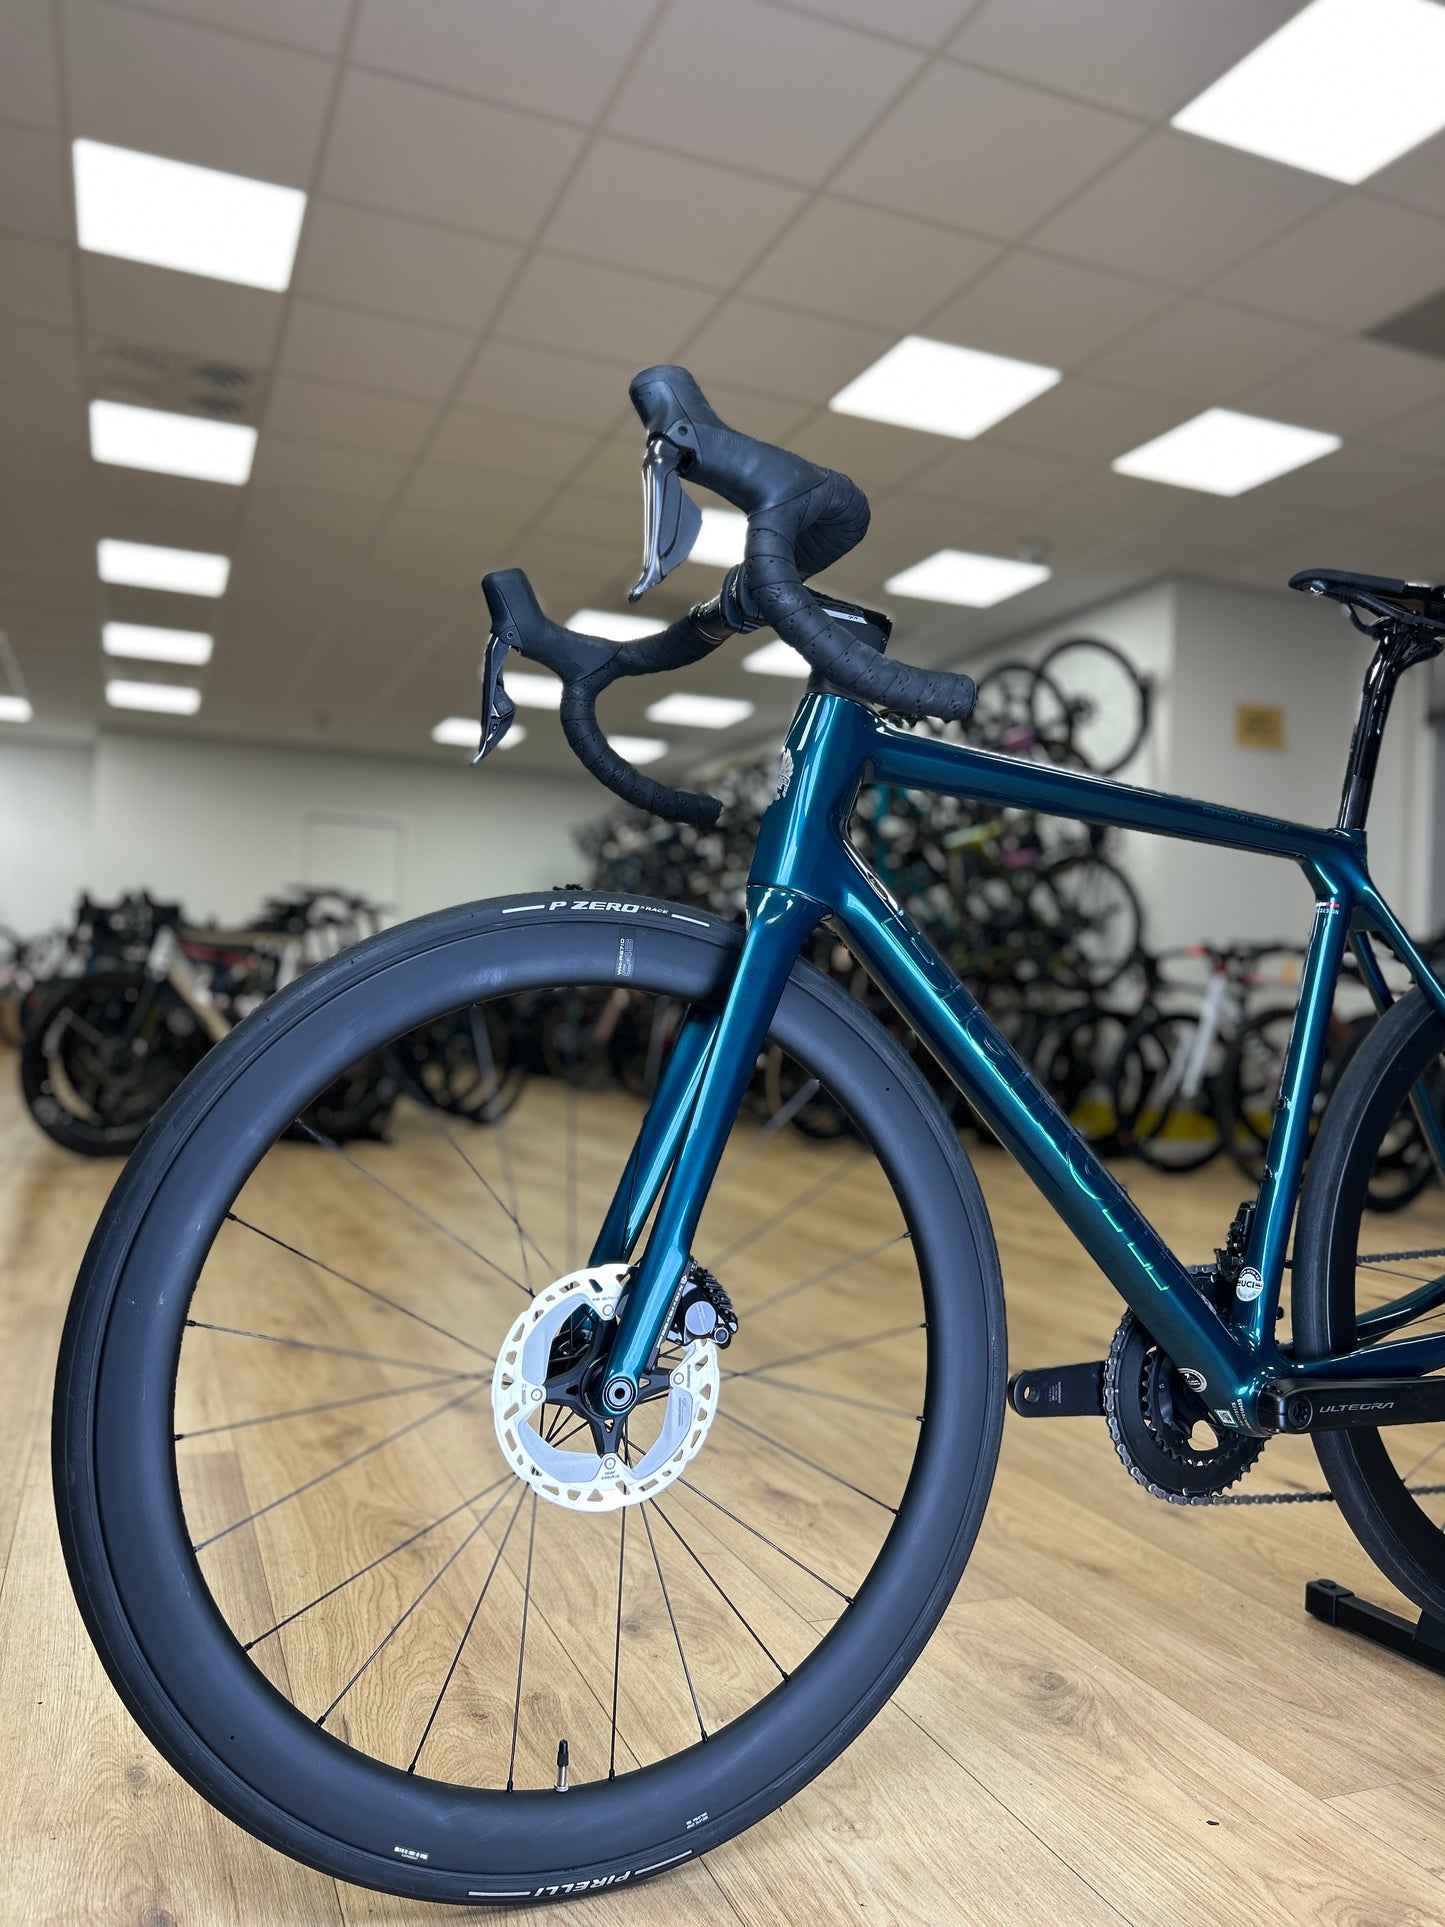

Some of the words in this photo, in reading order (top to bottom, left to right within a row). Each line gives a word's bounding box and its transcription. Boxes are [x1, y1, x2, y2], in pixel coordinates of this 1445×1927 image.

[549, 901, 567, 911] P
[570, 901, 640, 914] ZERO
[1241, 1280, 1255, 1288] UCI
[1319, 1401, 1395, 1413] ULTEGRA
[533, 1870, 632, 1897] PIRELLI
